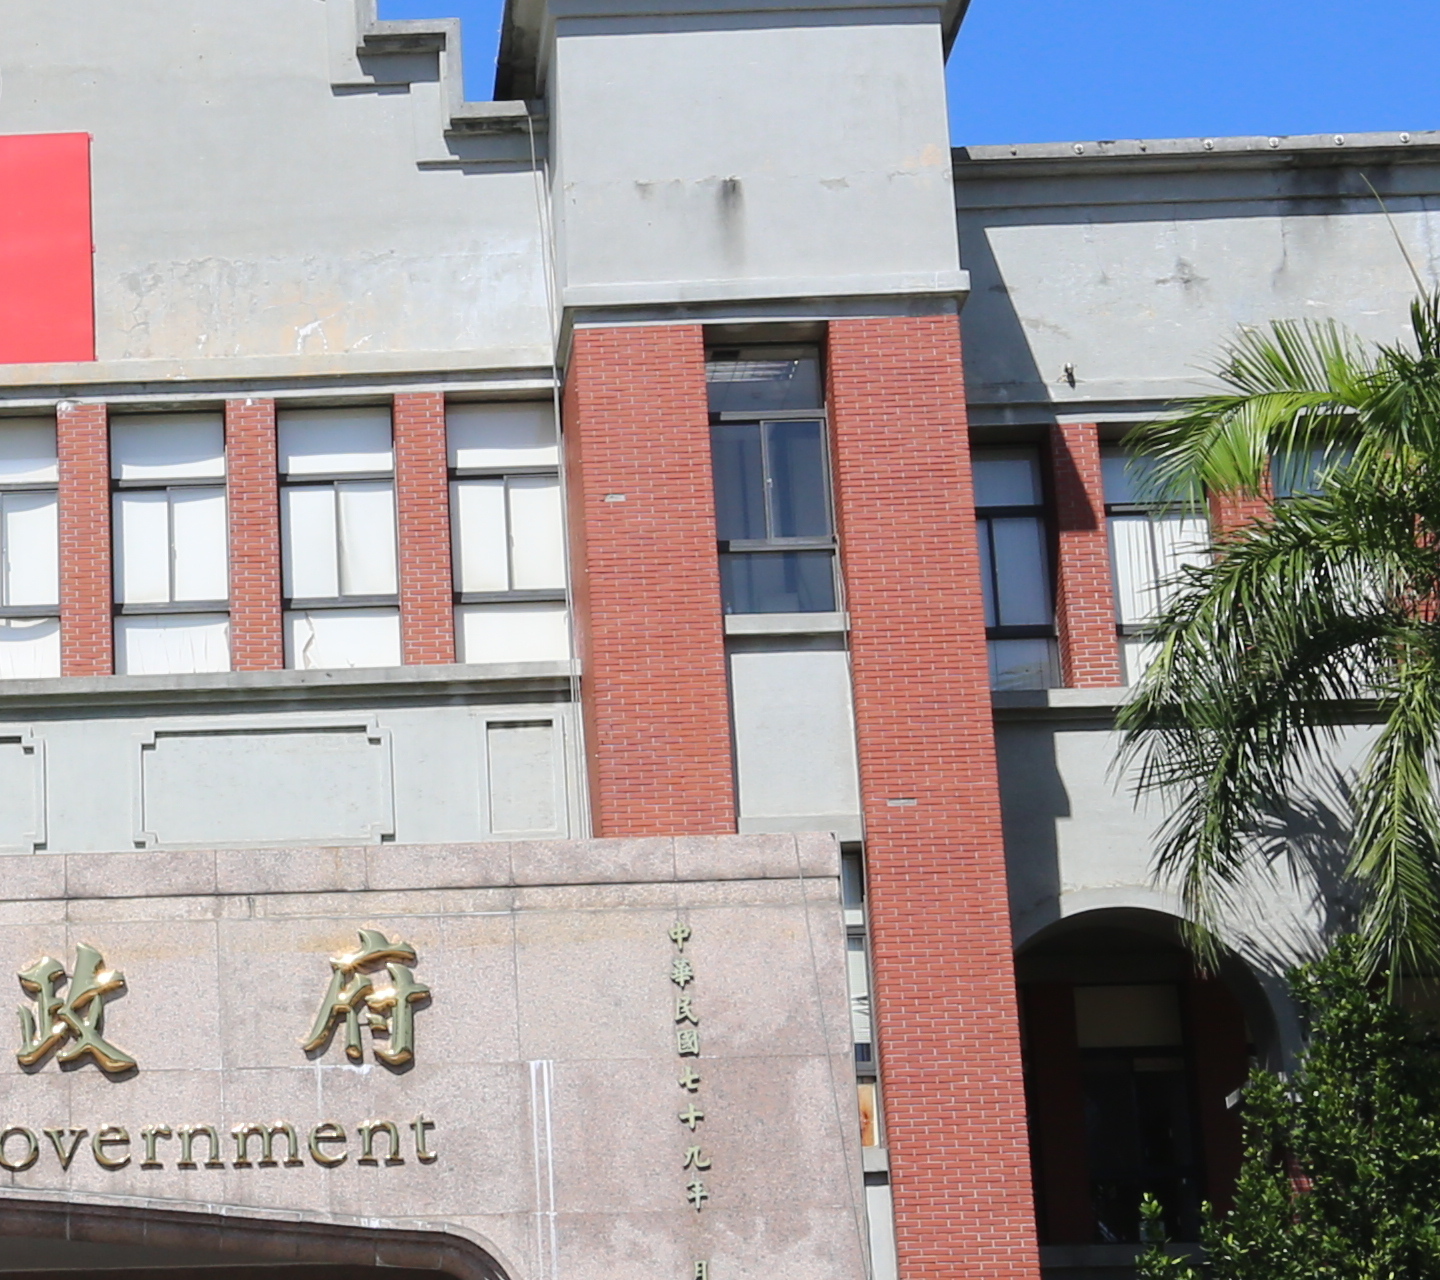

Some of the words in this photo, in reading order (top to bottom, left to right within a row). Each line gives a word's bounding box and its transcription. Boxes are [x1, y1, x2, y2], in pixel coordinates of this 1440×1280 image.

[668, 921, 712, 1212] 中華民國七十九年
